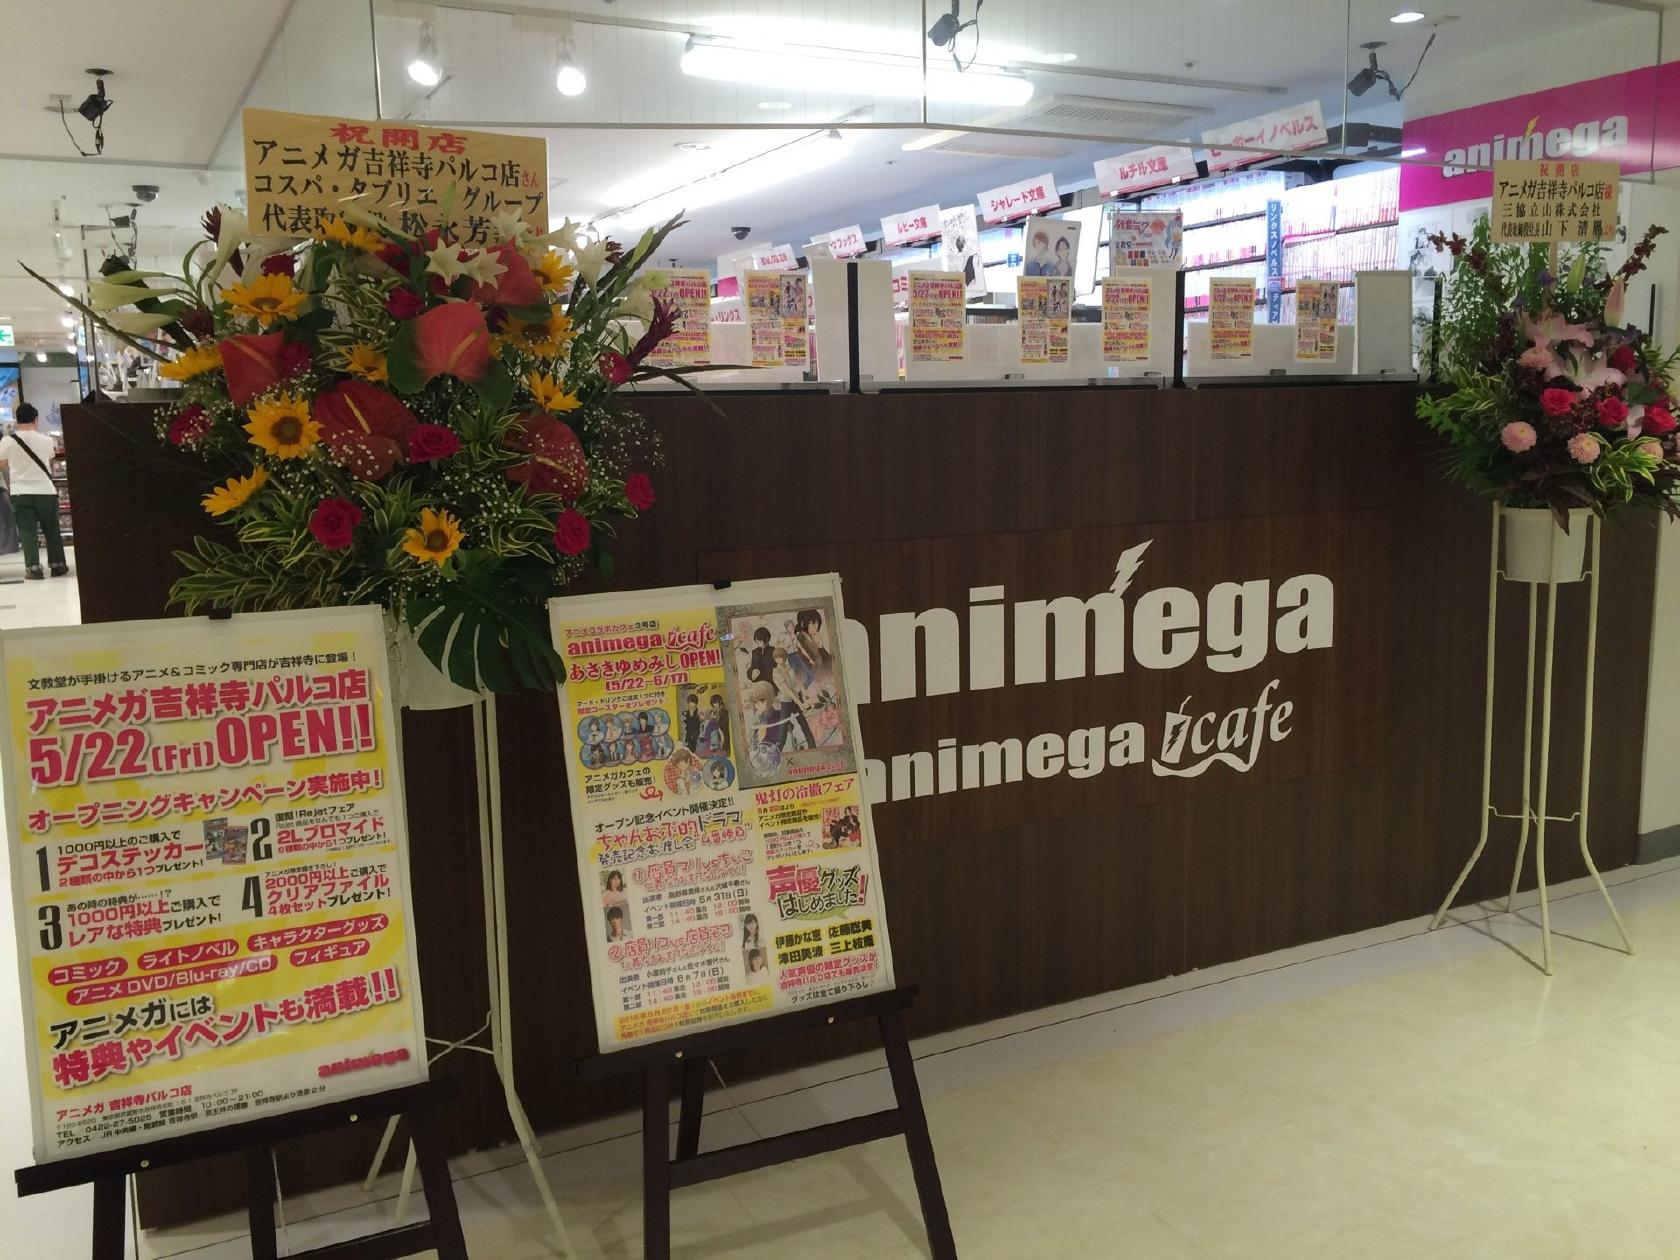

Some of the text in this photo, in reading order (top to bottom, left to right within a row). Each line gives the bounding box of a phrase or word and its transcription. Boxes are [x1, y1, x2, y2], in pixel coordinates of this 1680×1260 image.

[330, 123, 471, 155] 祝開店
[1442, 115, 1629, 178] animega
[1540, 163, 1580, 176] 祝開店
[567, 633, 662, 656] animega
[27, 669, 368, 733] アニメガ吉祥寺パルコ店
[585, 767, 651, 783] アニメガカフェの
[57, 841, 204, 876] デコステッカー
[250, 817, 273, 862] 2
[36, 845, 51, 892] 1
[266, 874, 390, 906] クリアファイル
[766, 865, 861, 901] 声優グッズ
[241, 875, 263, 918] 4
[37, 904, 63, 951] 3
[52, 915, 386, 983] コミック ライトノベル キャラクターグッズ
[73, 983, 124, 1003] アニメ
[294, 940, 366, 965] フィギュア
[49, 997, 213, 1049] アニメガには
[52, 967, 397, 1085] 特典やイベントも満載!!
[56, 1135, 91, 1148] アクセス
